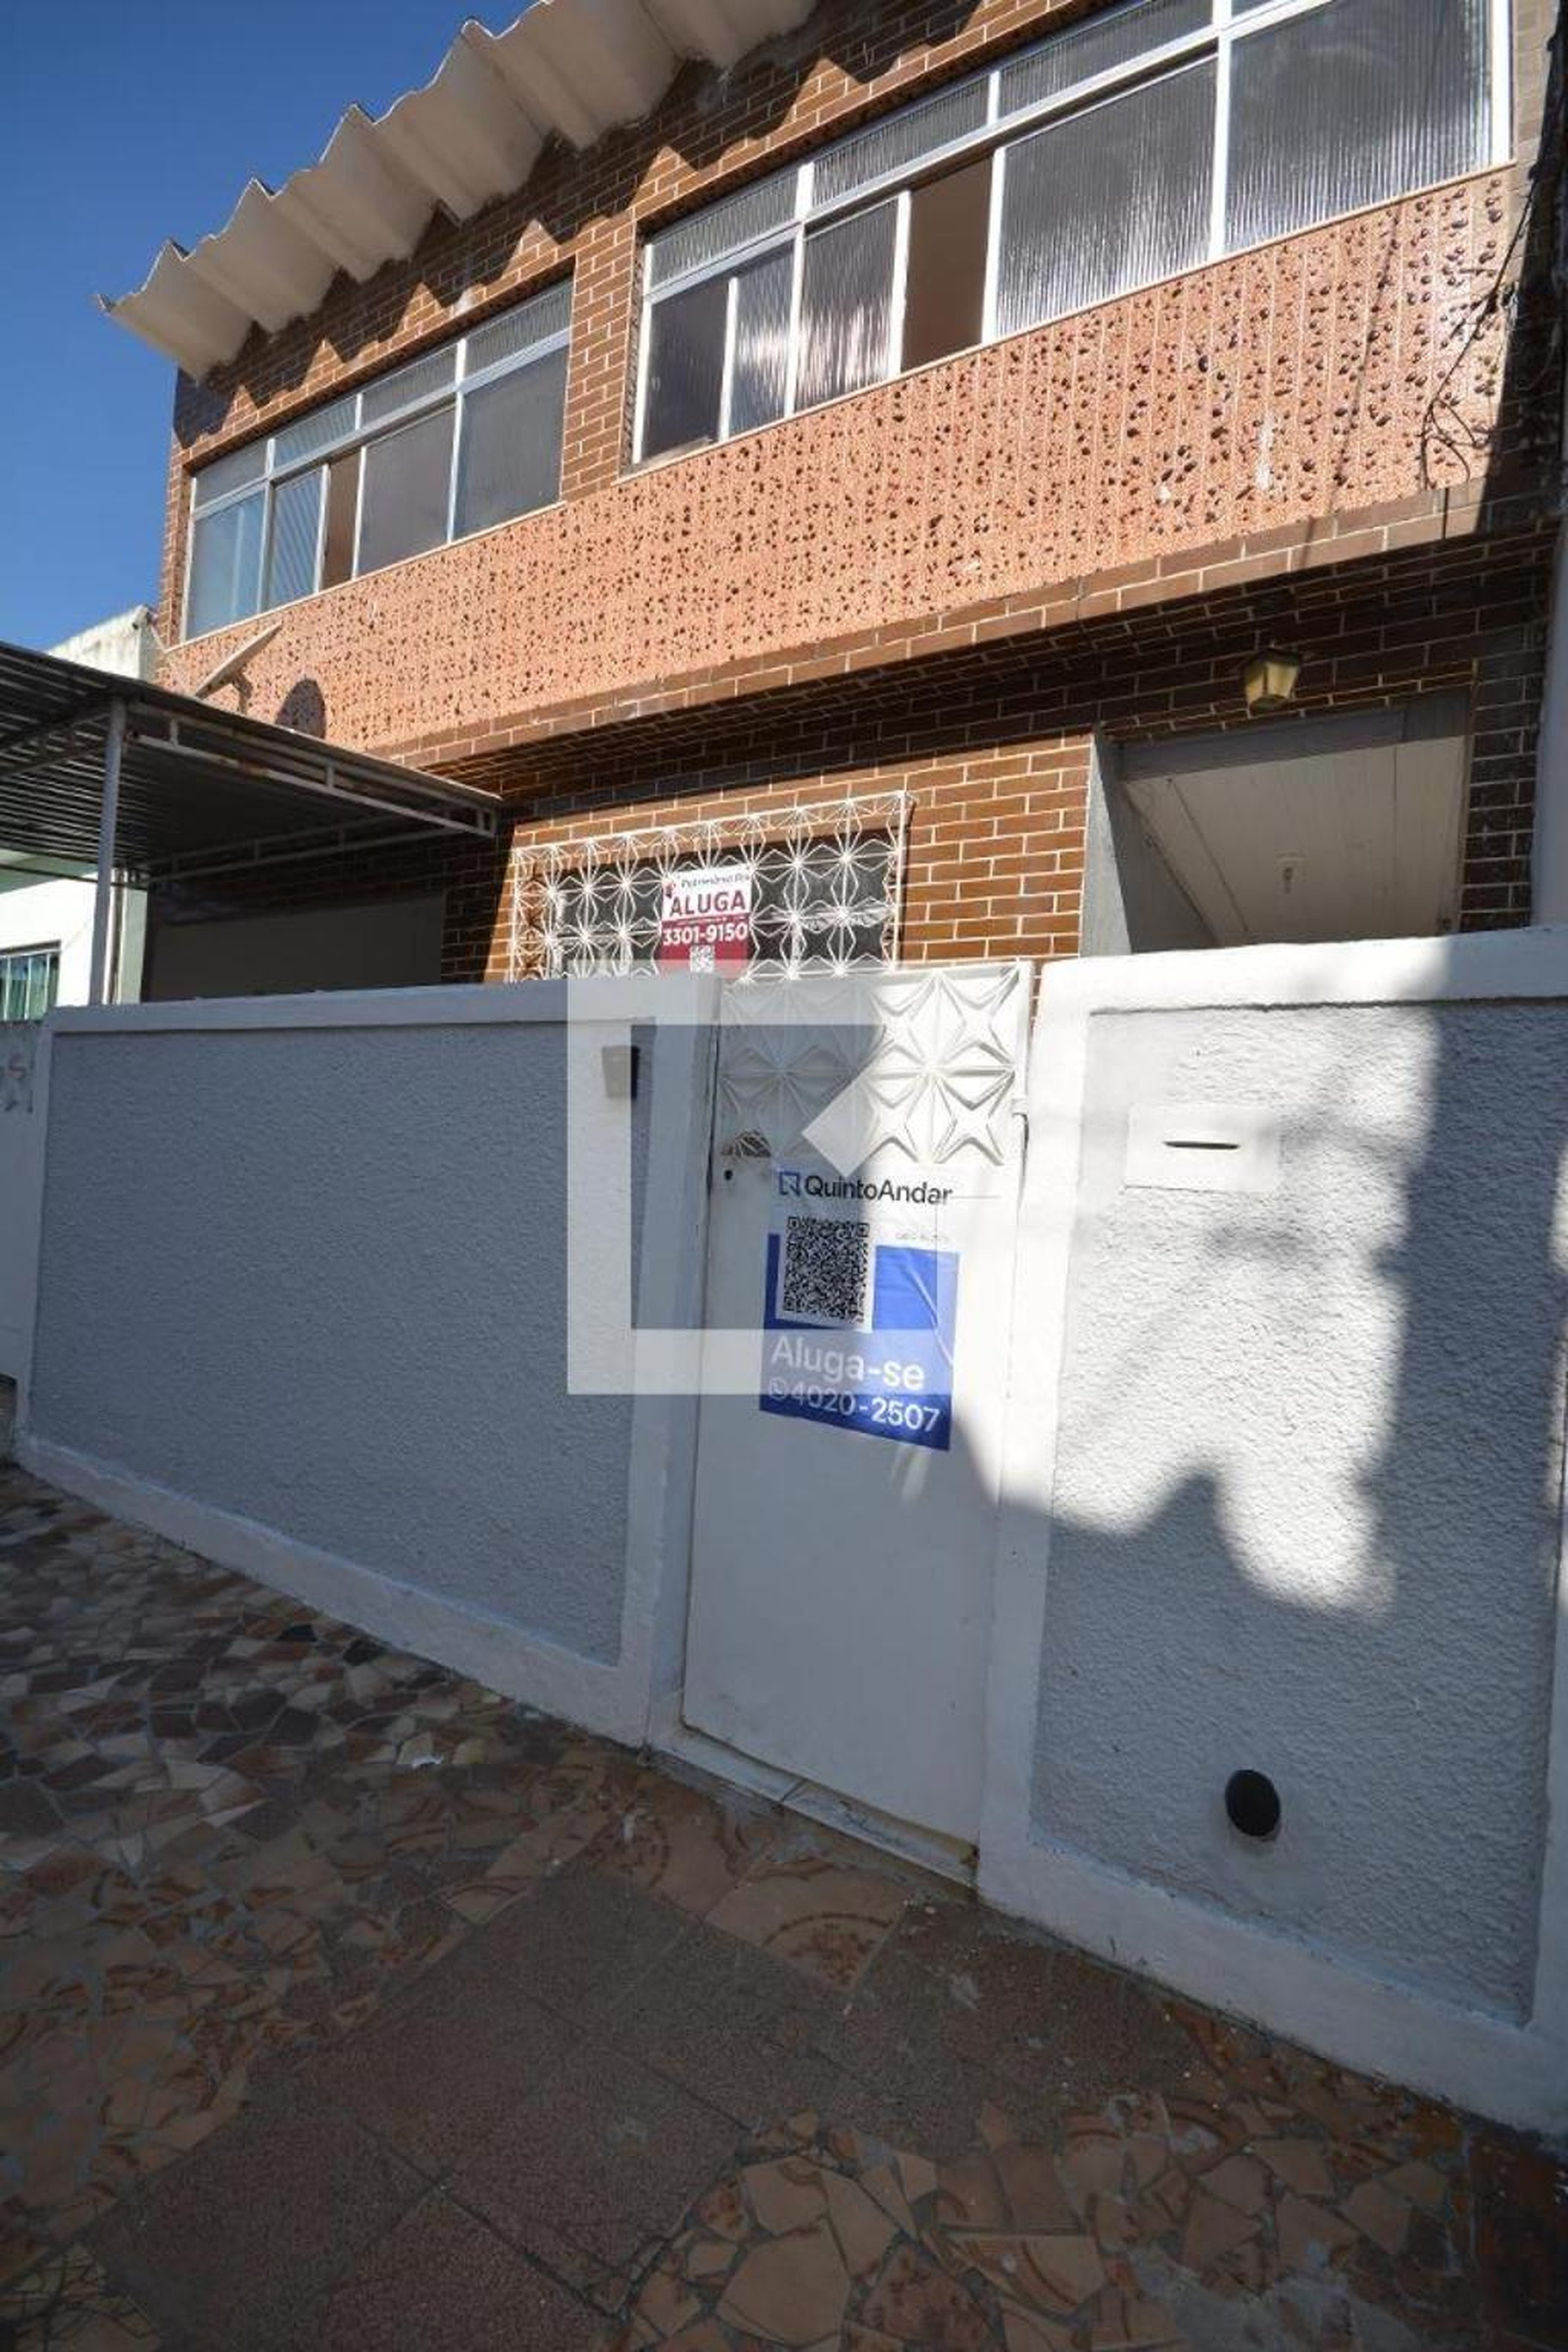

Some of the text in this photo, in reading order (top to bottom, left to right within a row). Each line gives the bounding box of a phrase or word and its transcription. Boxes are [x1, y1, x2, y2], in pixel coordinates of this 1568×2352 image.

[670, 890, 746, 916] ALUGA
[663, 923, 748, 946] 3301-9150
[805, 1176, 953, 1204] QuintoAndar
[771, 1335, 925, 1390] Aluga-se
